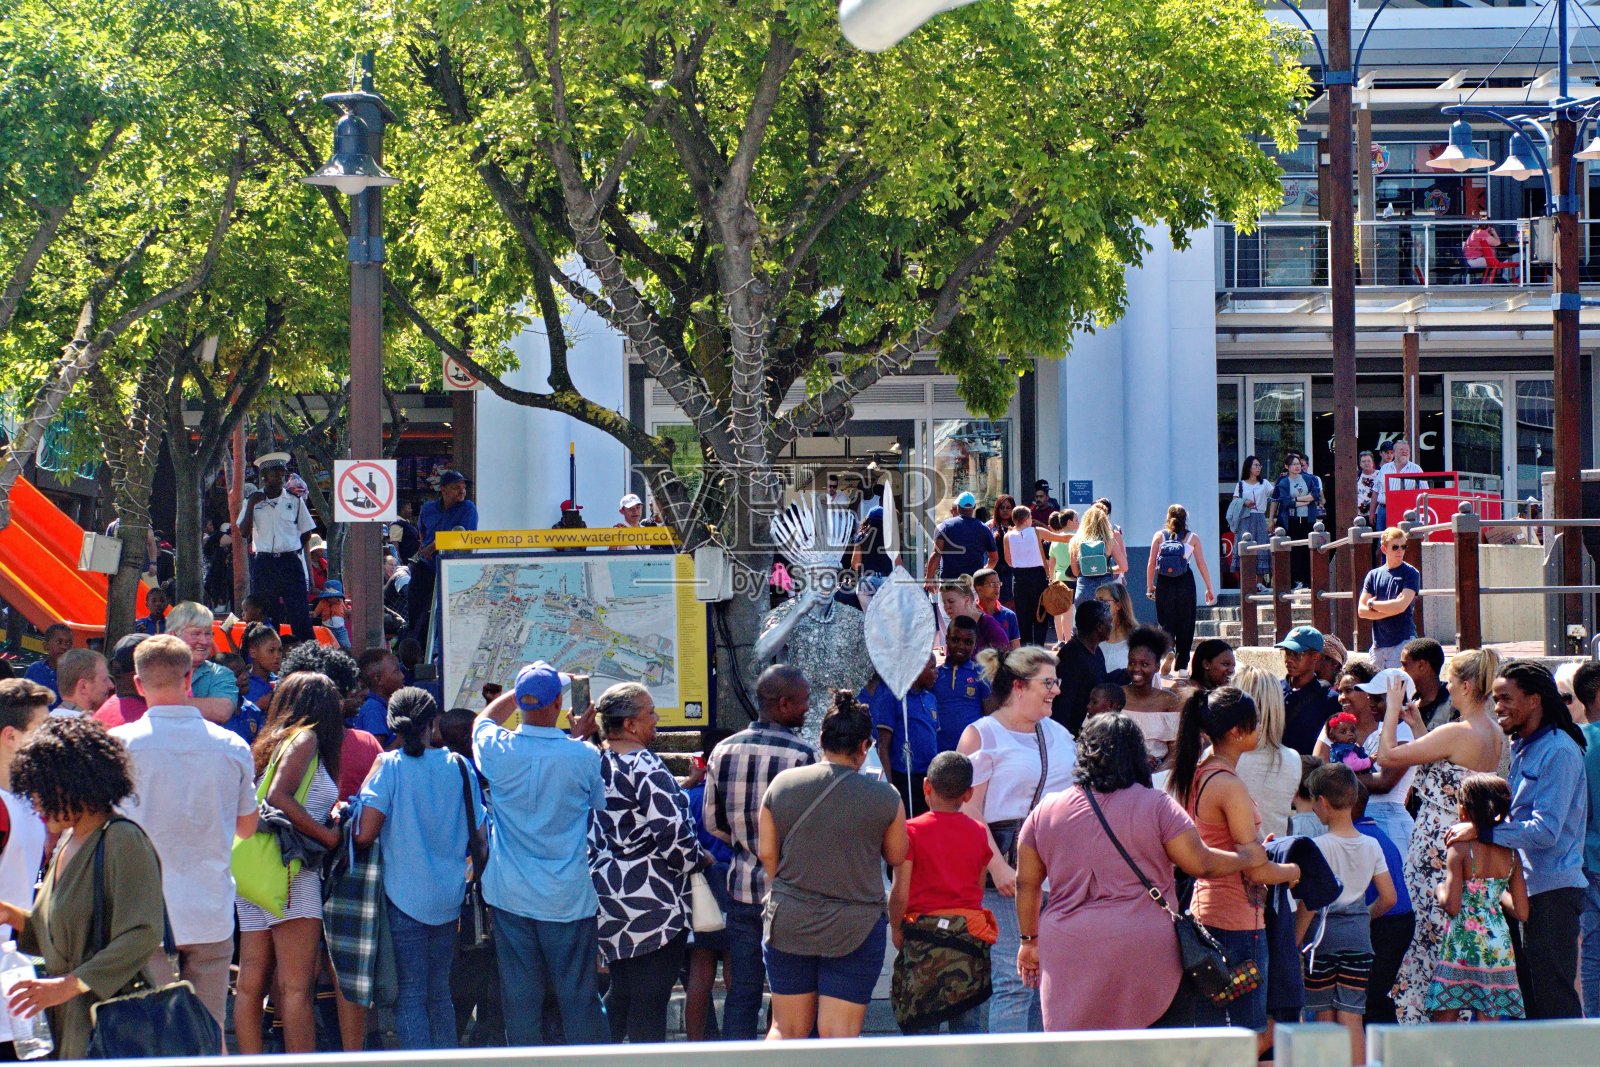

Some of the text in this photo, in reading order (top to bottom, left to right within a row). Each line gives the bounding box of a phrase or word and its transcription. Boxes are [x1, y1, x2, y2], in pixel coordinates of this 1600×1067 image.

[1375, 431, 1438, 451] KC
[460, 533, 493, 545] View
[496, 535, 523, 547] map
[527, 534, 540, 544] at
